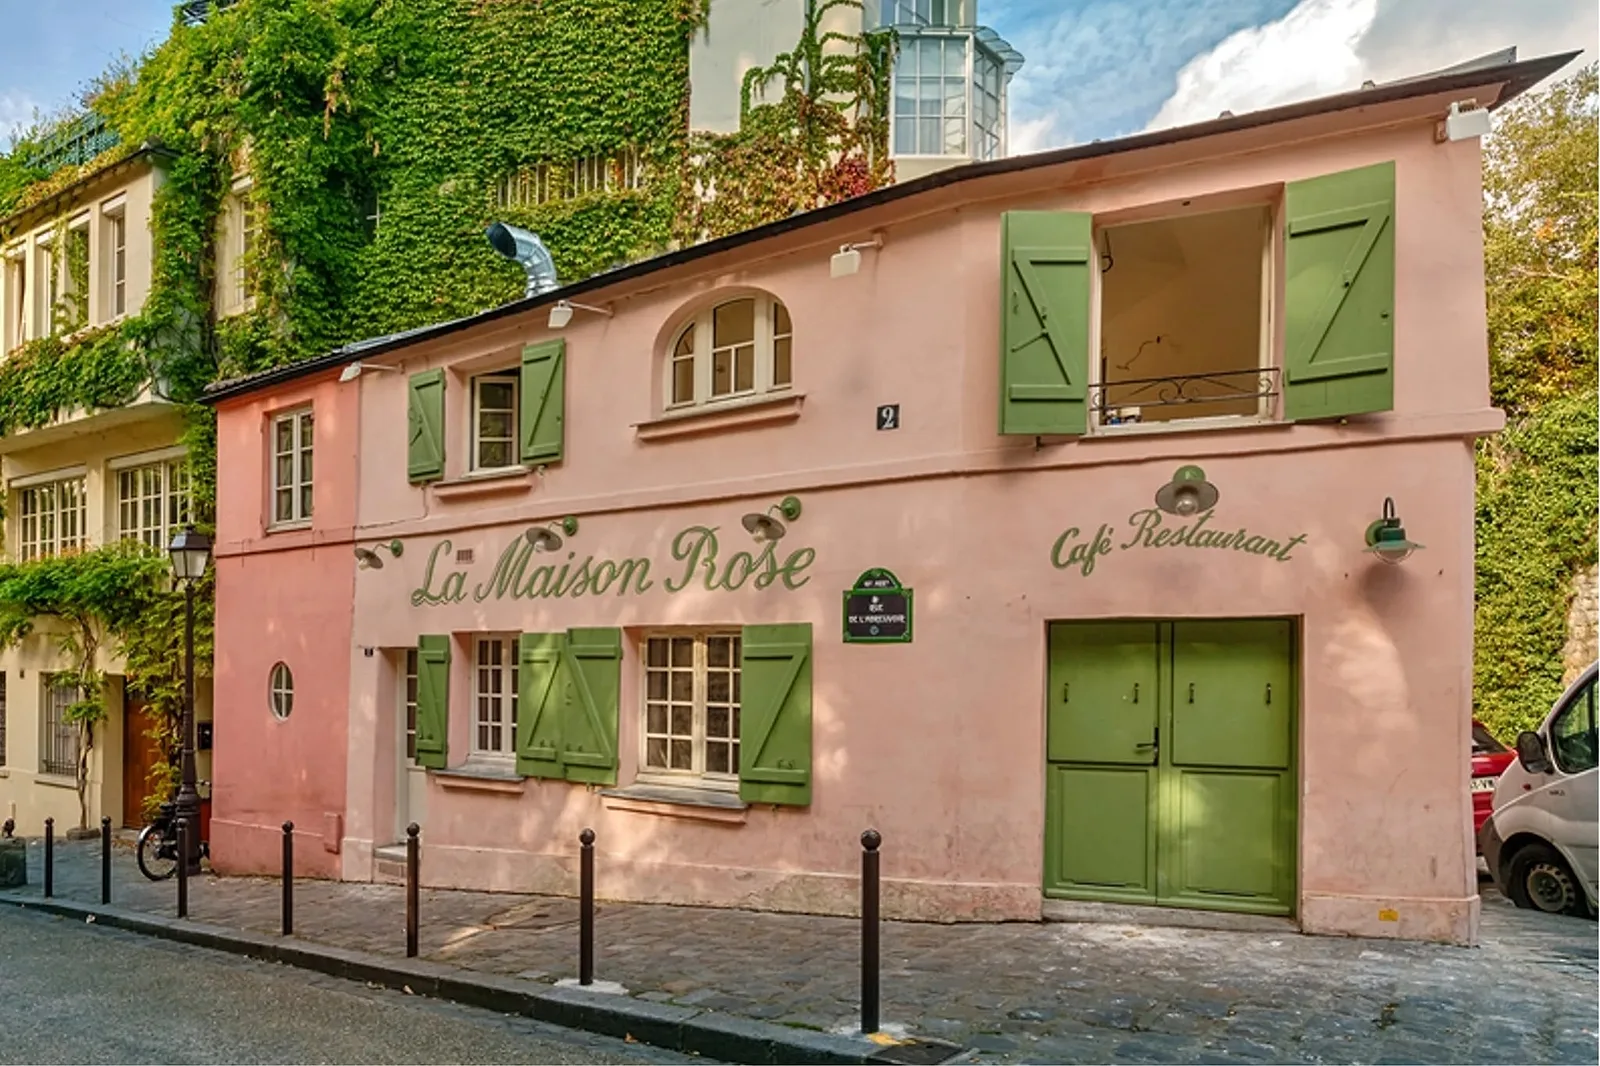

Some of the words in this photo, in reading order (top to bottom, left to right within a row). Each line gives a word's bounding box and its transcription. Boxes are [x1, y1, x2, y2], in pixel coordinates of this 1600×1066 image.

[882, 406, 895, 429] 2
[410, 538, 468, 607] La
[473, 532, 654, 604] Maison
[664, 525, 816, 593] Rose
[1050, 523, 1114, 577] Café
[1120, 508, 1308, 562] Restaurant
